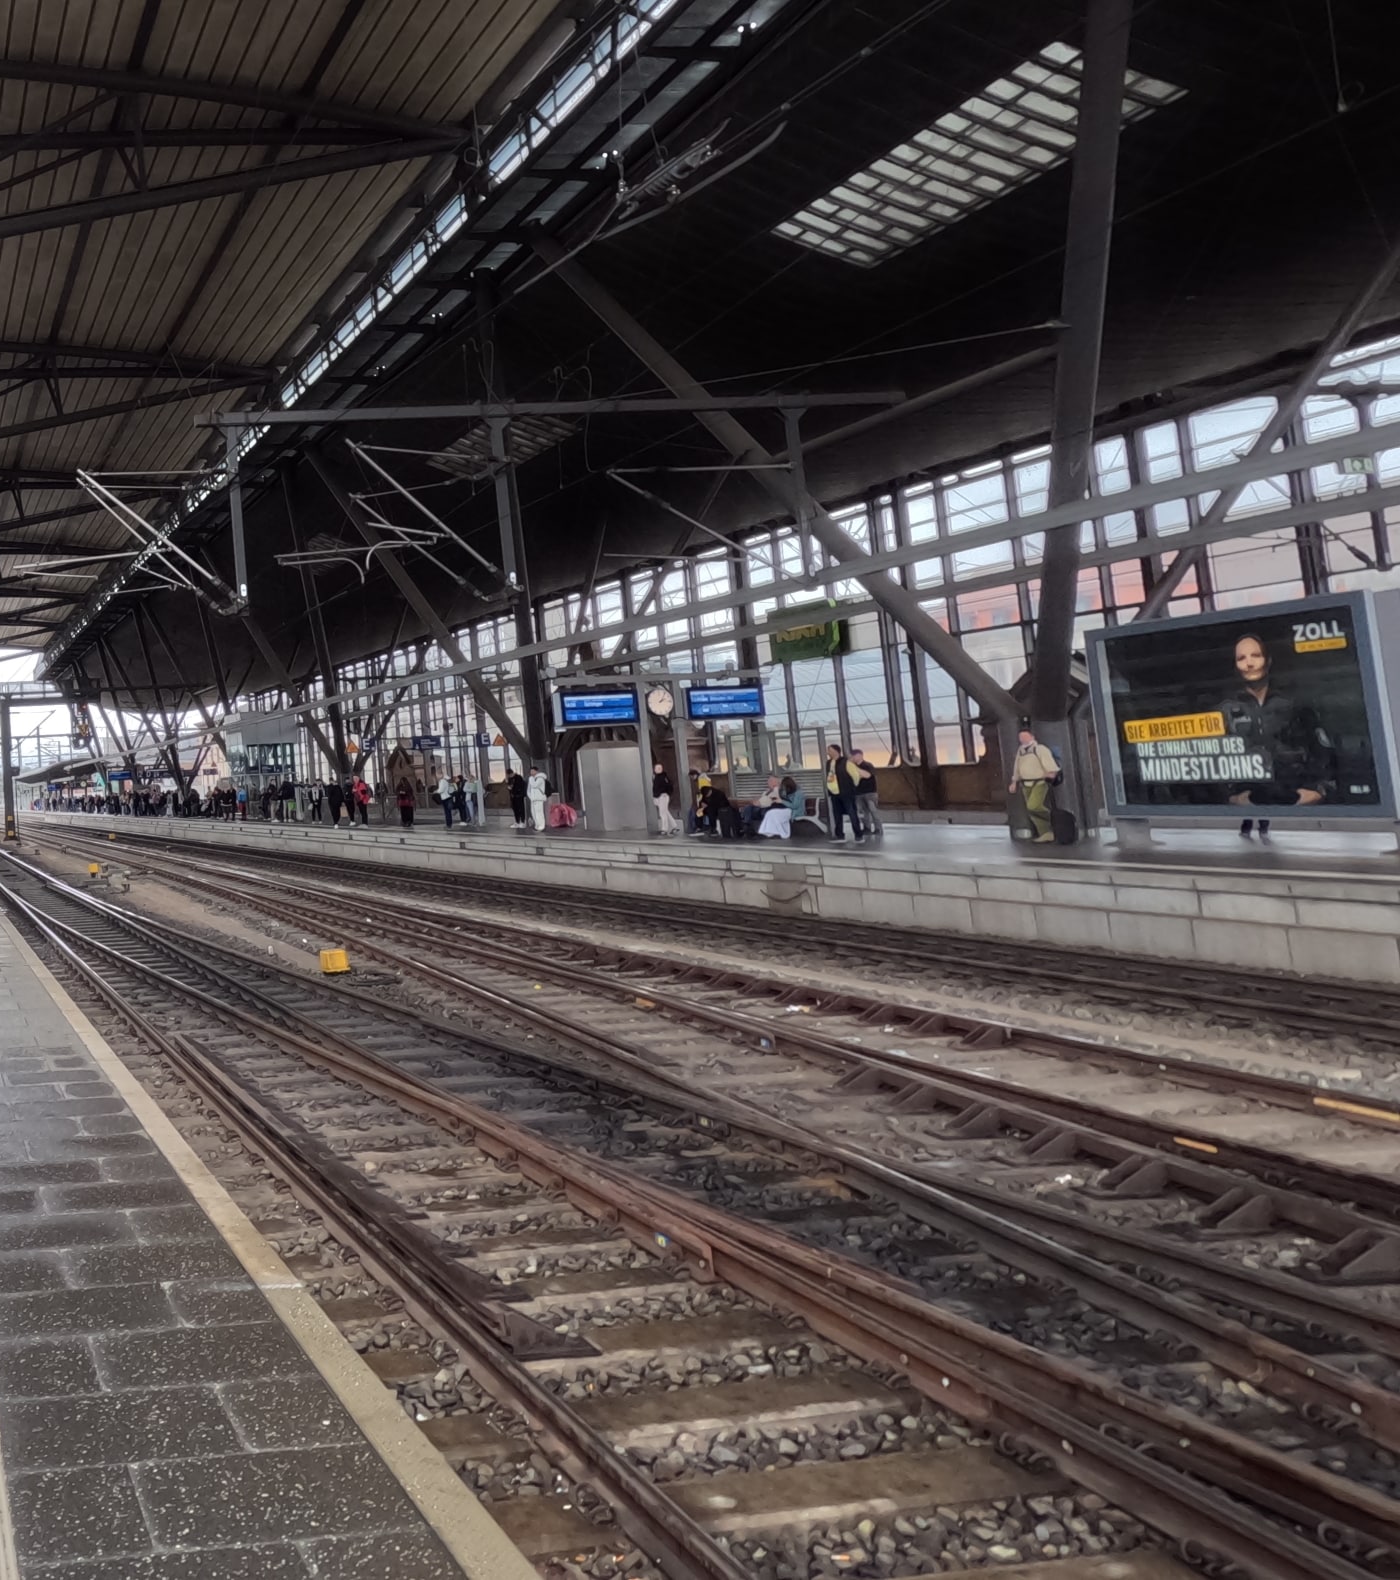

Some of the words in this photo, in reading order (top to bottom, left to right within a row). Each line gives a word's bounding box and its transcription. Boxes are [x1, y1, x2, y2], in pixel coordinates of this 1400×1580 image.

[1292, 620, 1345, 642] ZOLL
[1127, 723, 1145, 740] SIE
[1149, 719, 1196, 738] ARBEITET
[1199, 715, 1222, 733] FÜR
[481, 733, 489, 745] E
[1137, 742, 1156, 757] DIE
[1158, 739, 1221, 757] EINHALTUNG
[1222, 737, 1245, 754] DES
[1139, 754, 1272, 782] MINDESTLOHNS.
